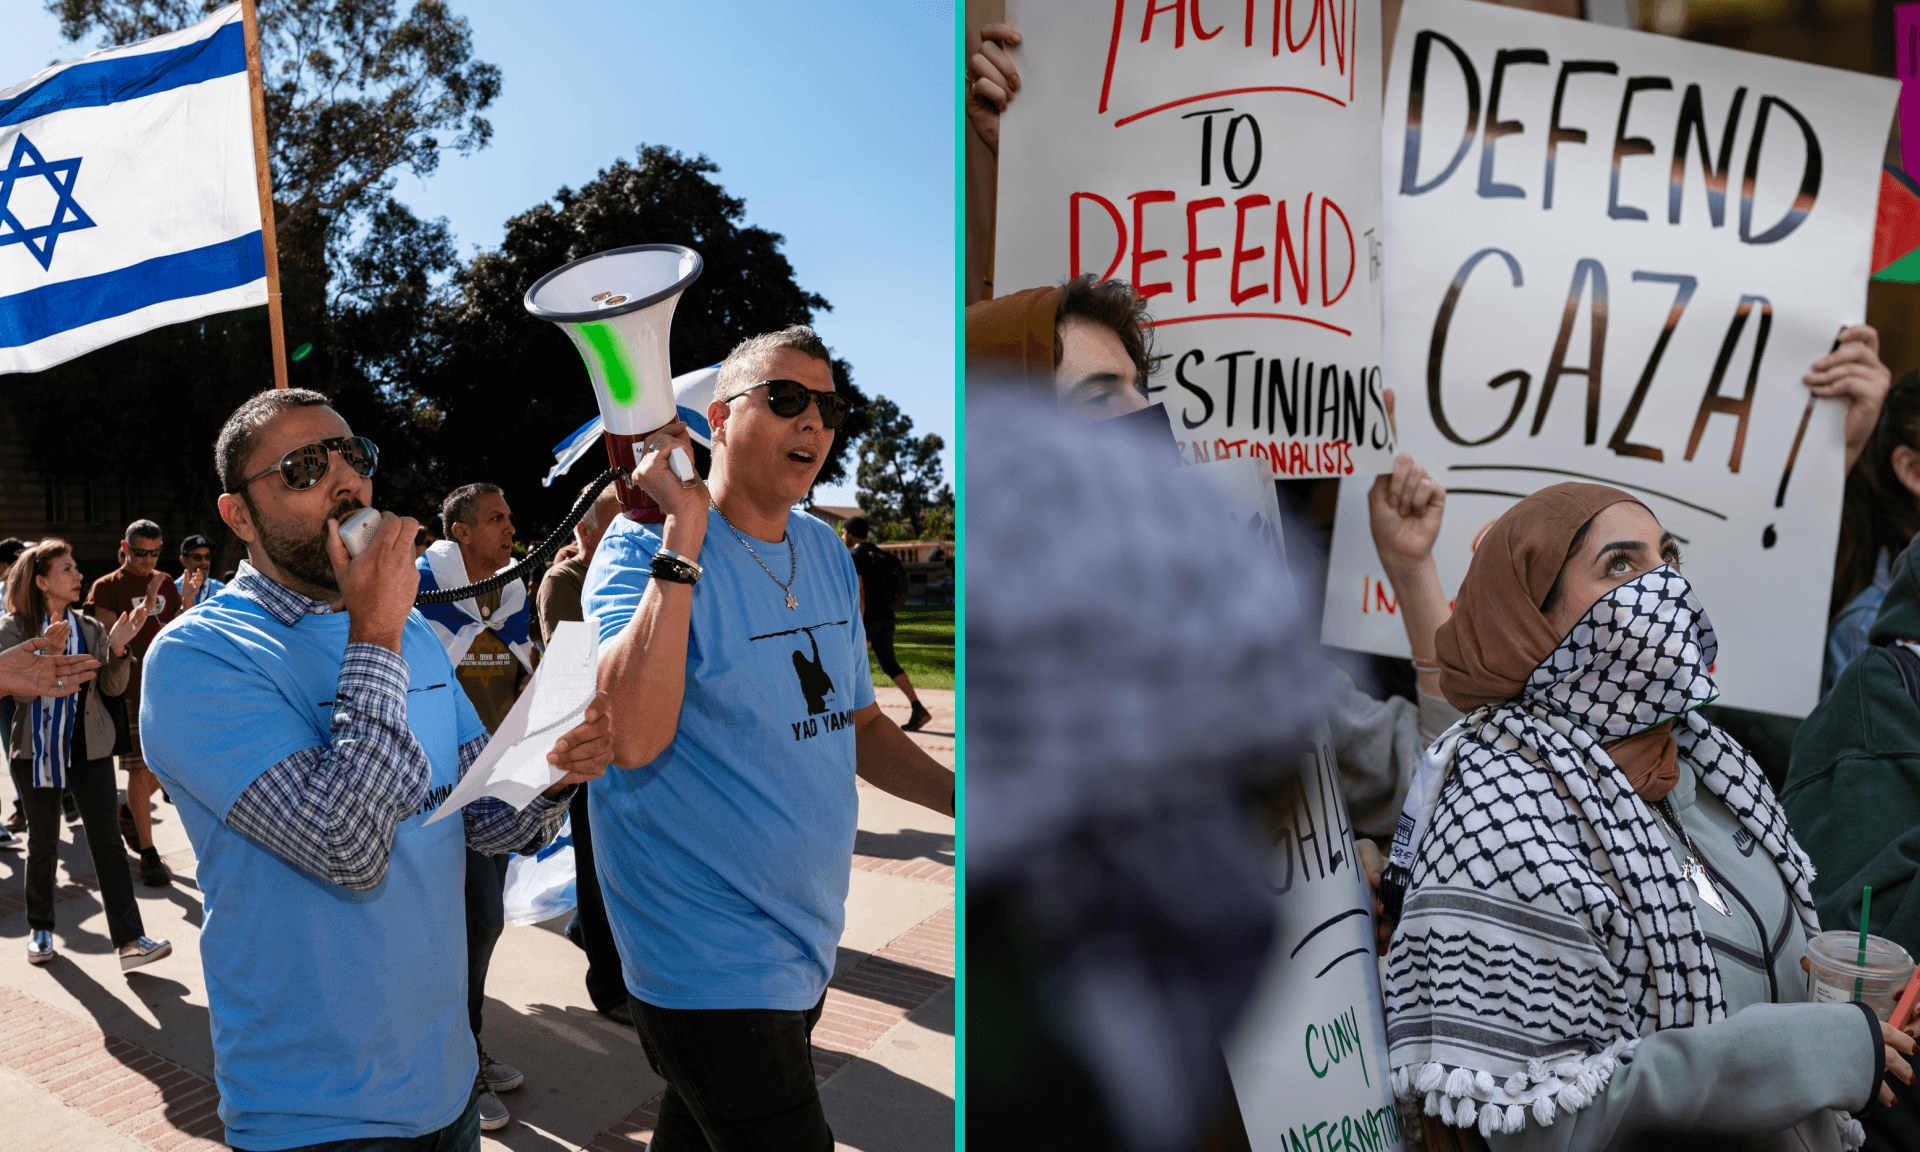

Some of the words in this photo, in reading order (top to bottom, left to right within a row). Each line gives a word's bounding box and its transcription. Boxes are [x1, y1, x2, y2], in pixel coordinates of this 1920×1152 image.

[1182, 107, 1263, 190] TO
[1400, 29, 1823, 246] DEFEND
[1070, 188, 1356, 308] DEFEND
[1427, 247, 1849, 549] GAZA!
[791, 718, 818, 741] YAD
[1305, 1005, 1371, 1089] CUNY
